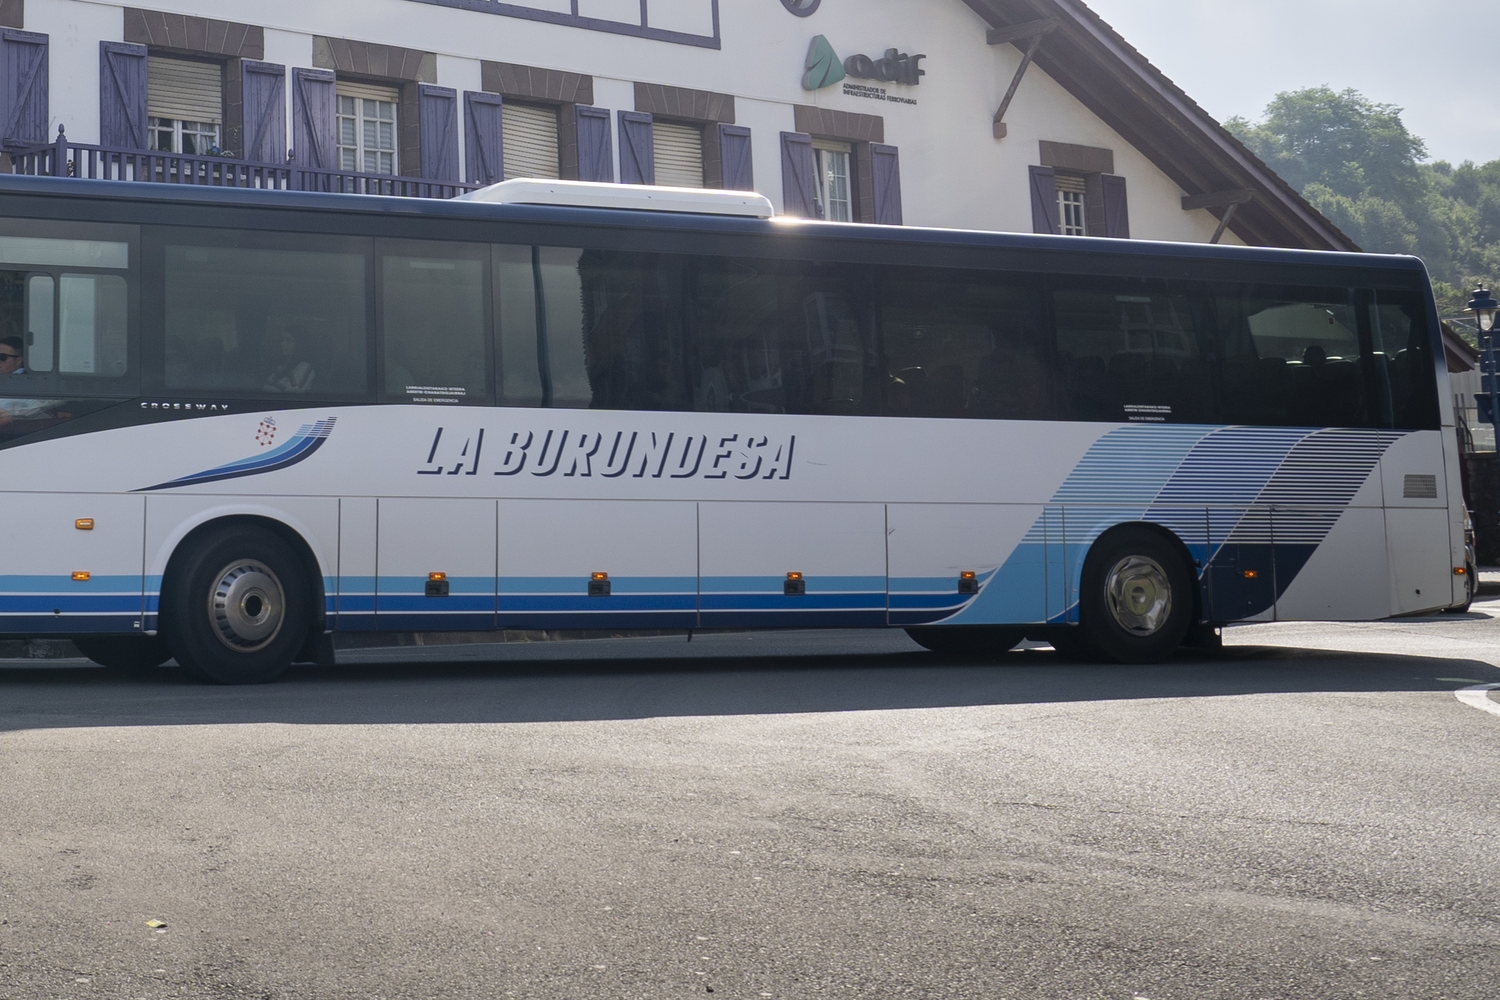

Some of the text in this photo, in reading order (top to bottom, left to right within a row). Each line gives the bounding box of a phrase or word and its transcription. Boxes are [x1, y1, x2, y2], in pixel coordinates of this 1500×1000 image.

[843, 48, 927, 86] adif
[140, 401, 229, 411] CROSSWAY
[416, 426, 797, 481] LA BURUNDESA
